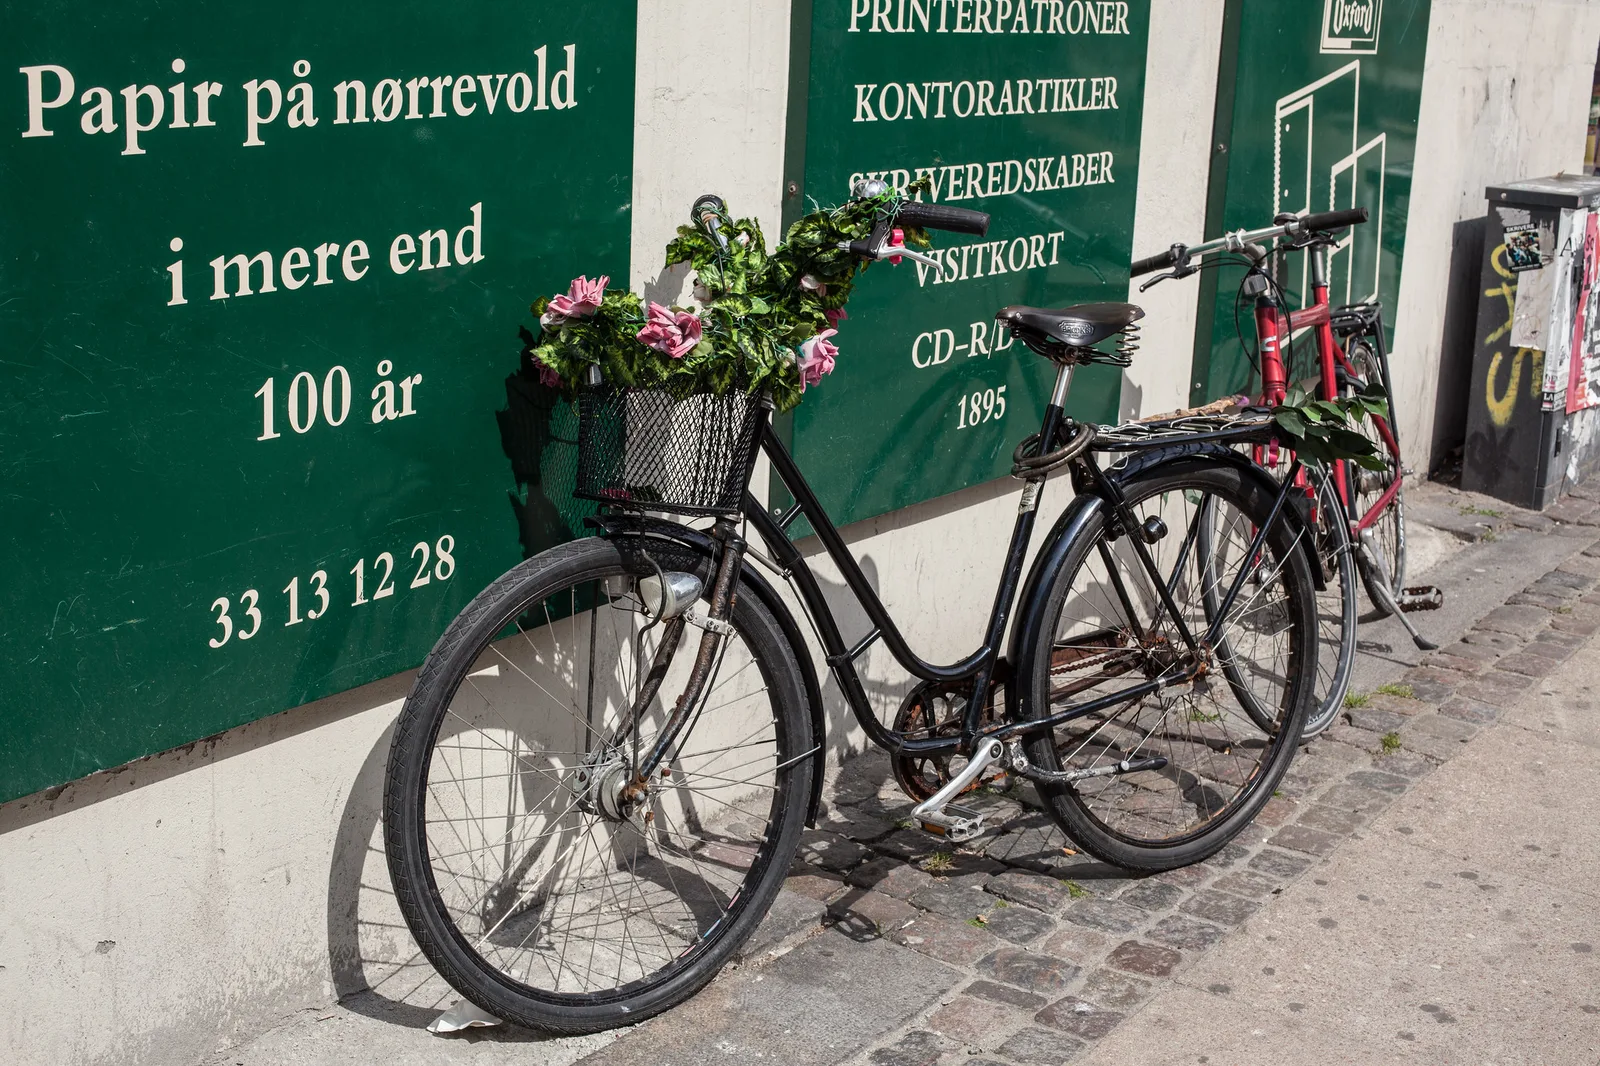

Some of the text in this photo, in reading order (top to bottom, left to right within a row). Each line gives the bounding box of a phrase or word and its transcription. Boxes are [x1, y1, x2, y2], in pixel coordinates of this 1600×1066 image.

[847, 0, 1131, 35] PRINTERPATRONER
[1333, 0, 1374, 35] Oxford
[19, 43, 578, 156] Papir på nørrevold
[852, 76, 1119, 123] KONTORARTIKLER
[166, 201, 485, 306] i mere end
[914, 230, 1065, 288] VISITKORT
[254, 359, 423, 442] 100 år
[956, 384, 1007, 430] 1895
[208, 534, 456, 649] 33 13 12 28
